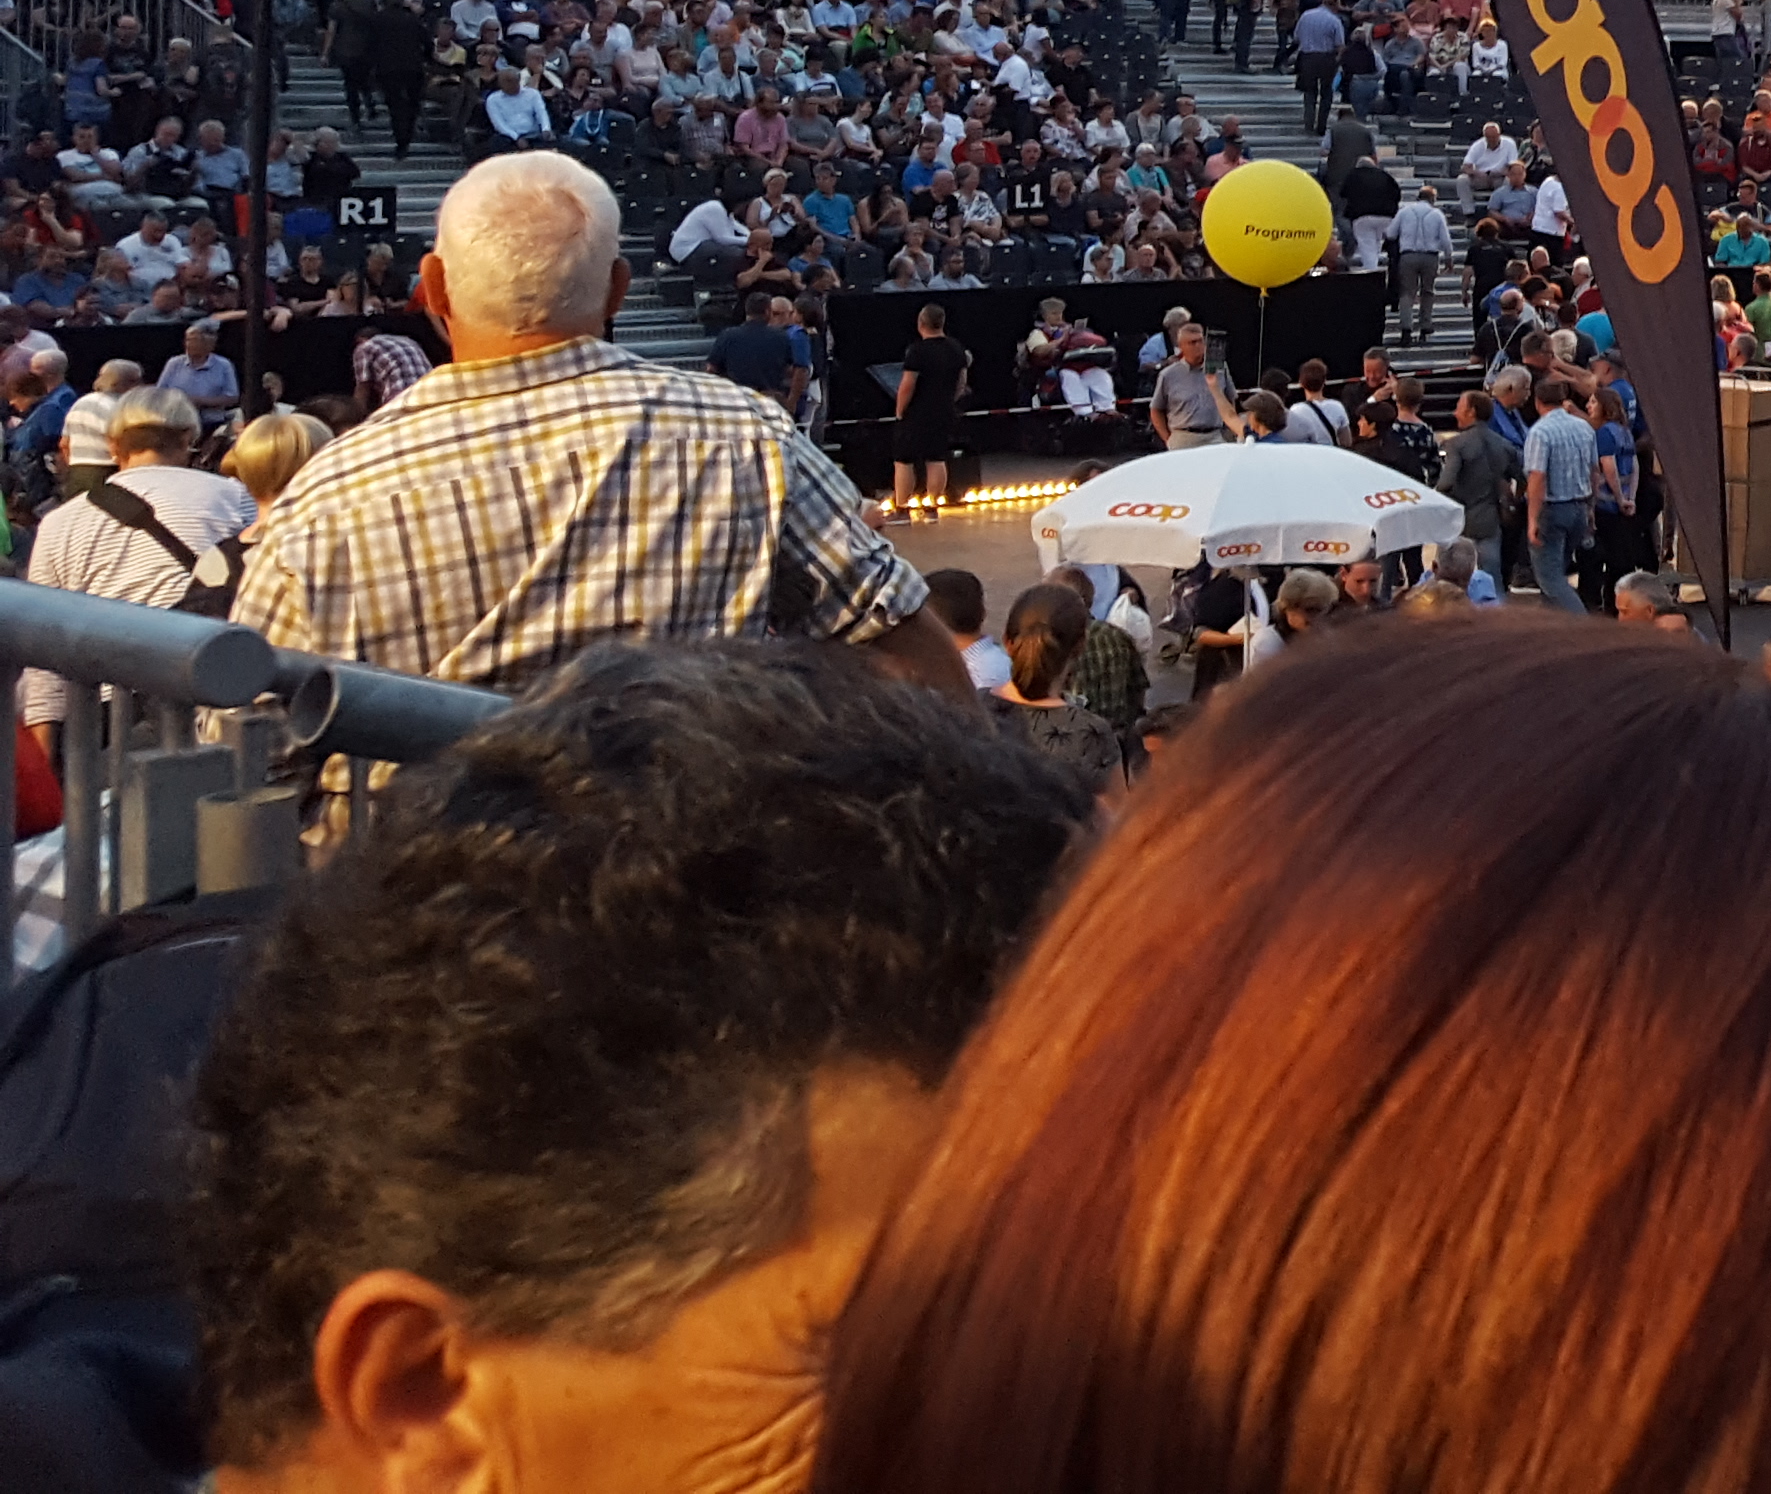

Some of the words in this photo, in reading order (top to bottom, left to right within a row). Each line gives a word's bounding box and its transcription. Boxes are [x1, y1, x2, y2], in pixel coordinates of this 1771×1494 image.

[1015, 183, 1044, 208] L1
[340, 196, 389, 225] R1
[1244, 225, 1316, 241] Programm
[1364, 488, 1421, 509] coop
[1108, 502, 1191, 523] coop
[1217, 542, 1262, 558] coop
[1303, 540, 1350, 556] coop
